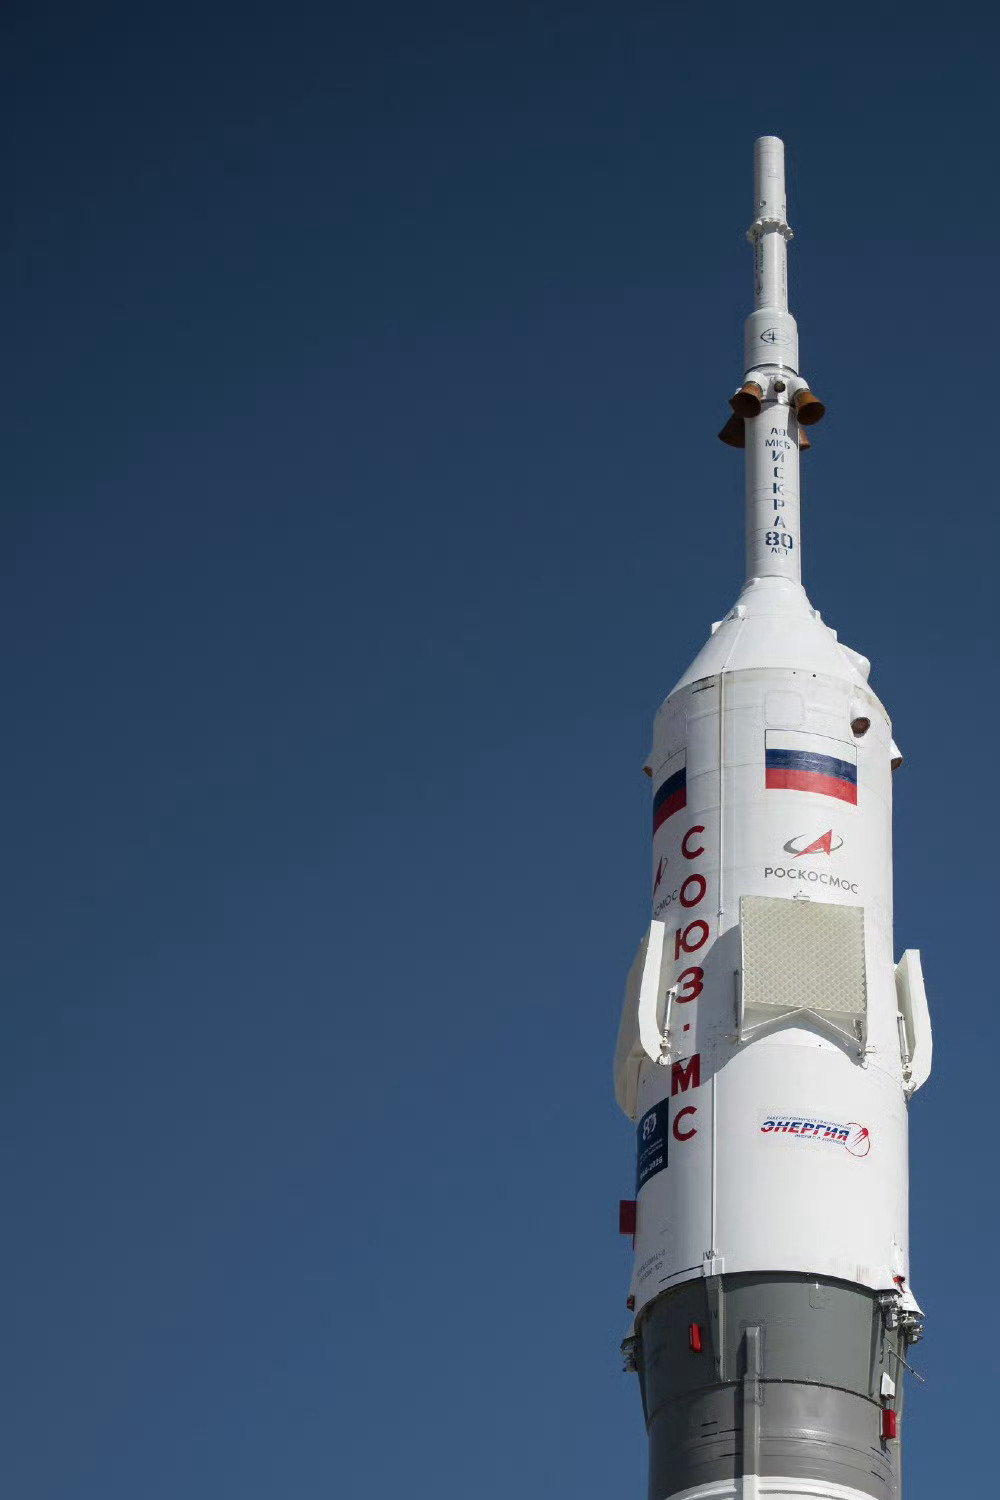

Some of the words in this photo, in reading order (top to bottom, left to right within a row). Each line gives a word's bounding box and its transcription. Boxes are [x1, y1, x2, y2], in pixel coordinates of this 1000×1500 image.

[765, 531, 793, 550] 80
[764, 866, 859, 894] РОСКОСМОС
[760, 1120, 850, 1142] ЭНЕРГИЯ
